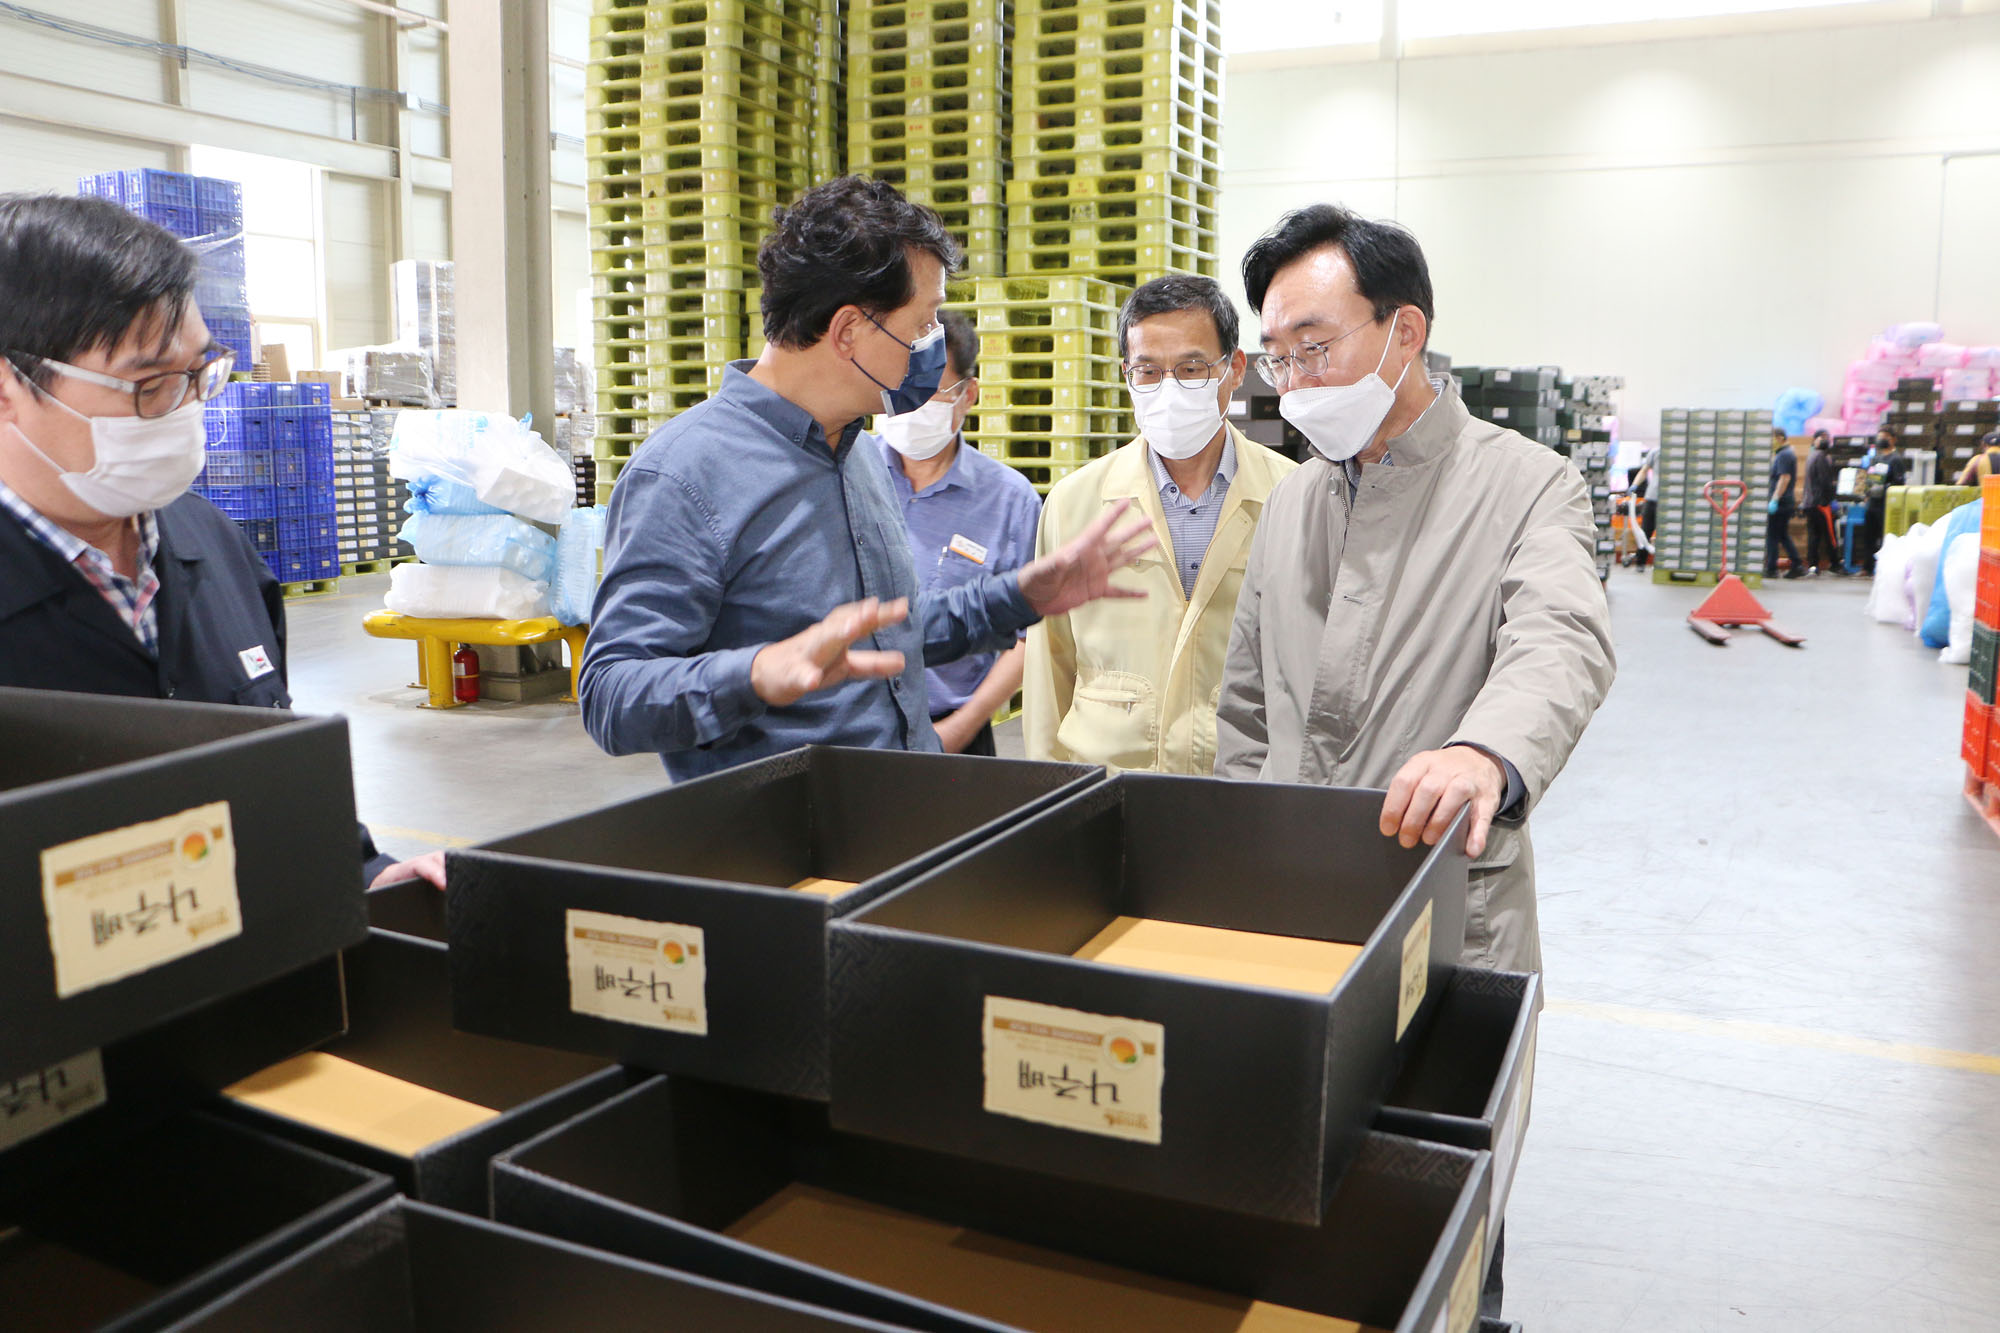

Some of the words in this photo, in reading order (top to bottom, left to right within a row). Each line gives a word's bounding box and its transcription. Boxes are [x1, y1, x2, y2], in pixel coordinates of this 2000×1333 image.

[90, 881, 200, 948] 나주배
[594, 964, 674, 1004] 나주배
[1018, 1058, 1120, 1106] 나주배
